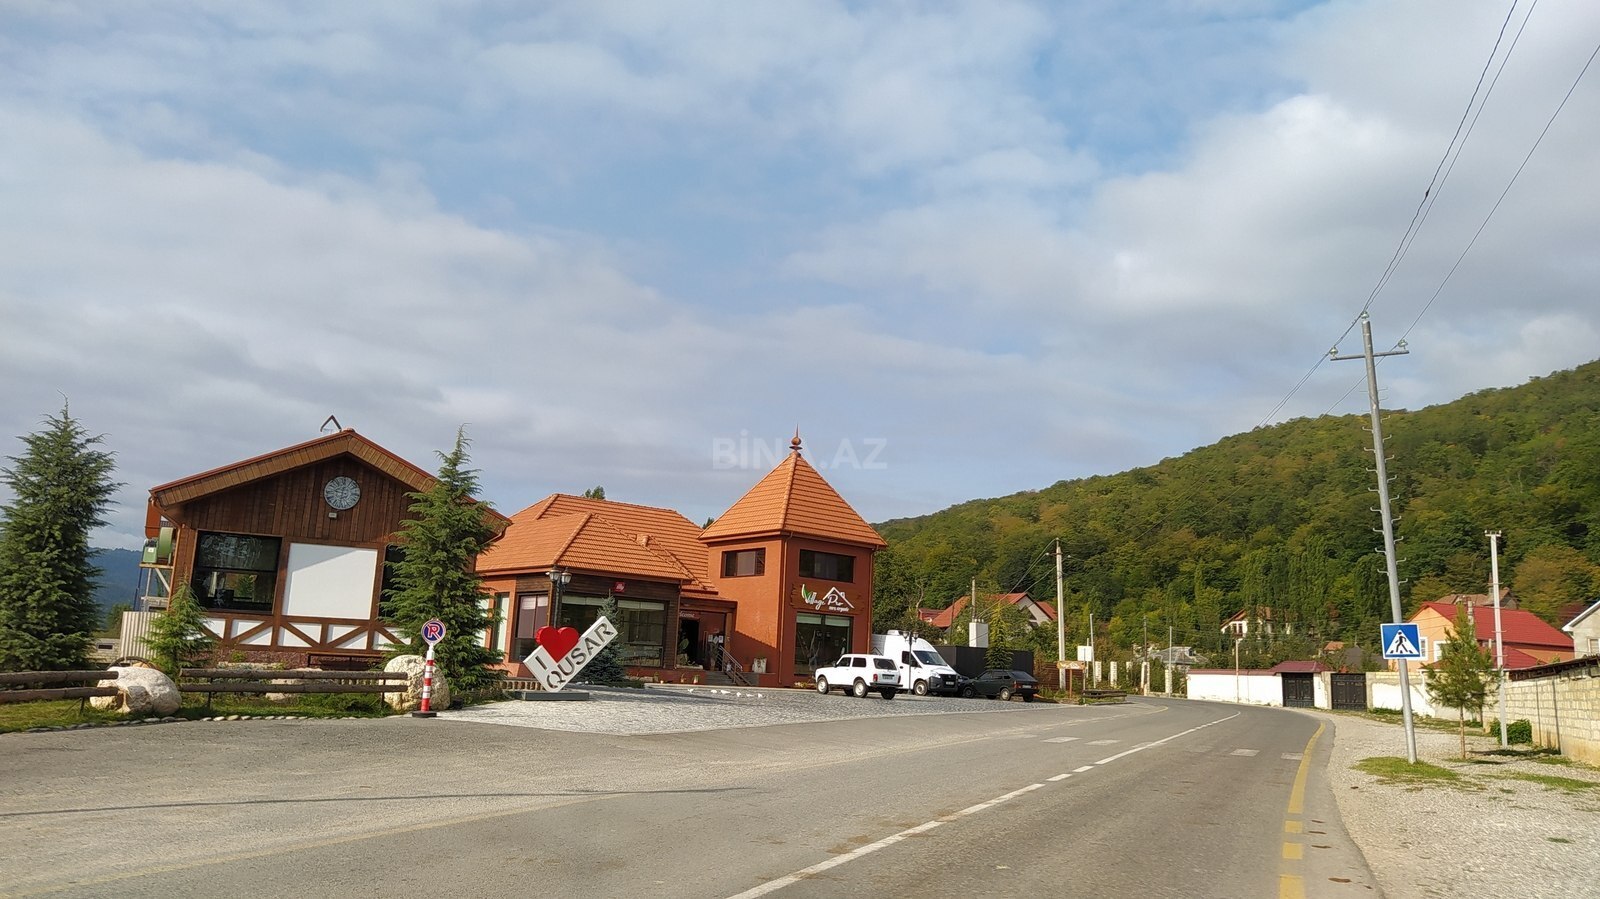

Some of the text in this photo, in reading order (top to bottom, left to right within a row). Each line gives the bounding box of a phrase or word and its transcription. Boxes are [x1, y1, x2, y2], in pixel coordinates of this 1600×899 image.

[801, 584, 843, 610] Village Pro
[534, 655, 547, 671] I
[546, 623, 614, 688] QUSAR
